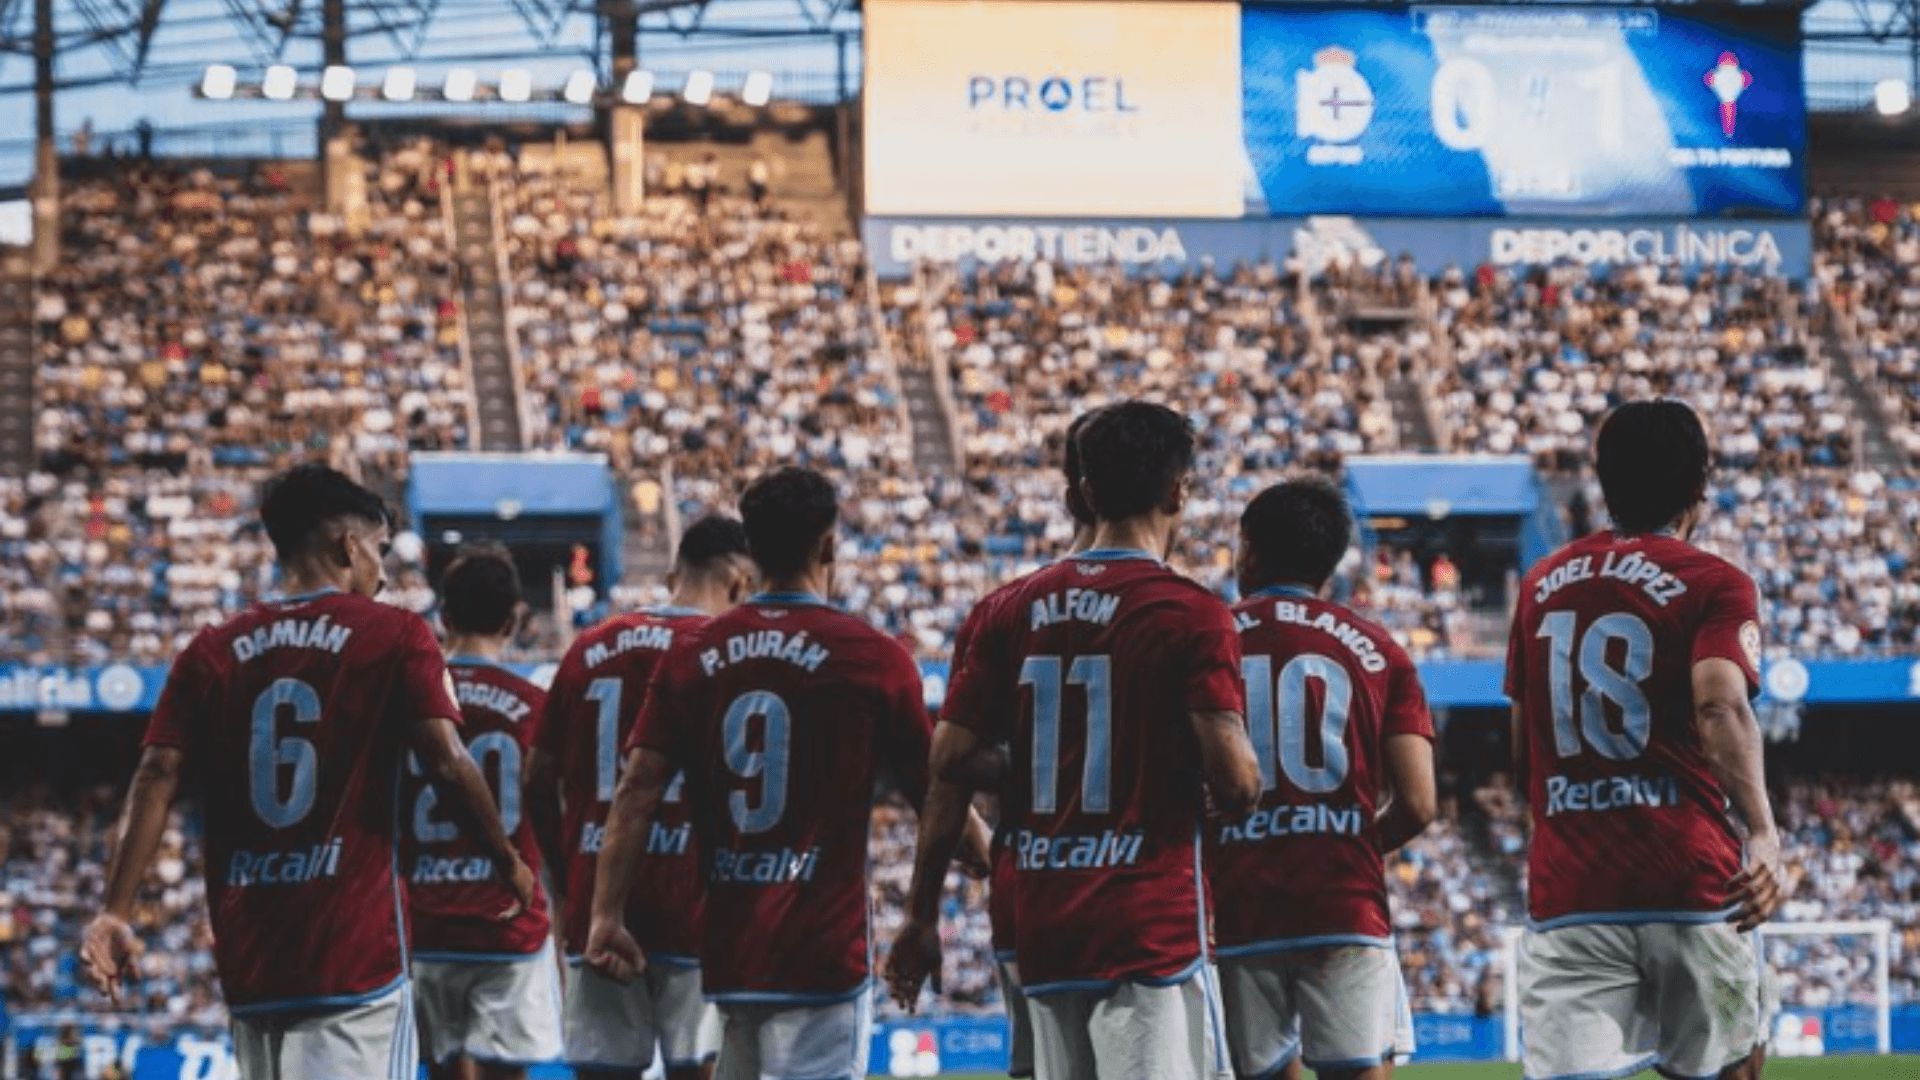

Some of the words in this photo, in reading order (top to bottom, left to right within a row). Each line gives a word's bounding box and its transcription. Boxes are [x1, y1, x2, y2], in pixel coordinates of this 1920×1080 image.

[967, 76, 1139, 112] PROEL
[891, 225, 1187, 262] DEPORTIENDA
[1535, 555, 1594, 603] JOEL
[1599, 550, 1687, 607] LÓPEZ
[1030, 588, 1120, 631] ALFON
[233, 614, 352, 663] DAMIÁN
[726, 630, 830, 673] DURÁN
[1535, 610, 1654, 759] 18
[1018, 654, 1113, 815] 11
[1240, 653, 1353, 794] 10
[251, 677, 321, 829] 6
[722, 689, 791, 834] 9
[1546, 775, 1678, 818] Recalvi
[1016, 830, 1144, 870] Recalvi
